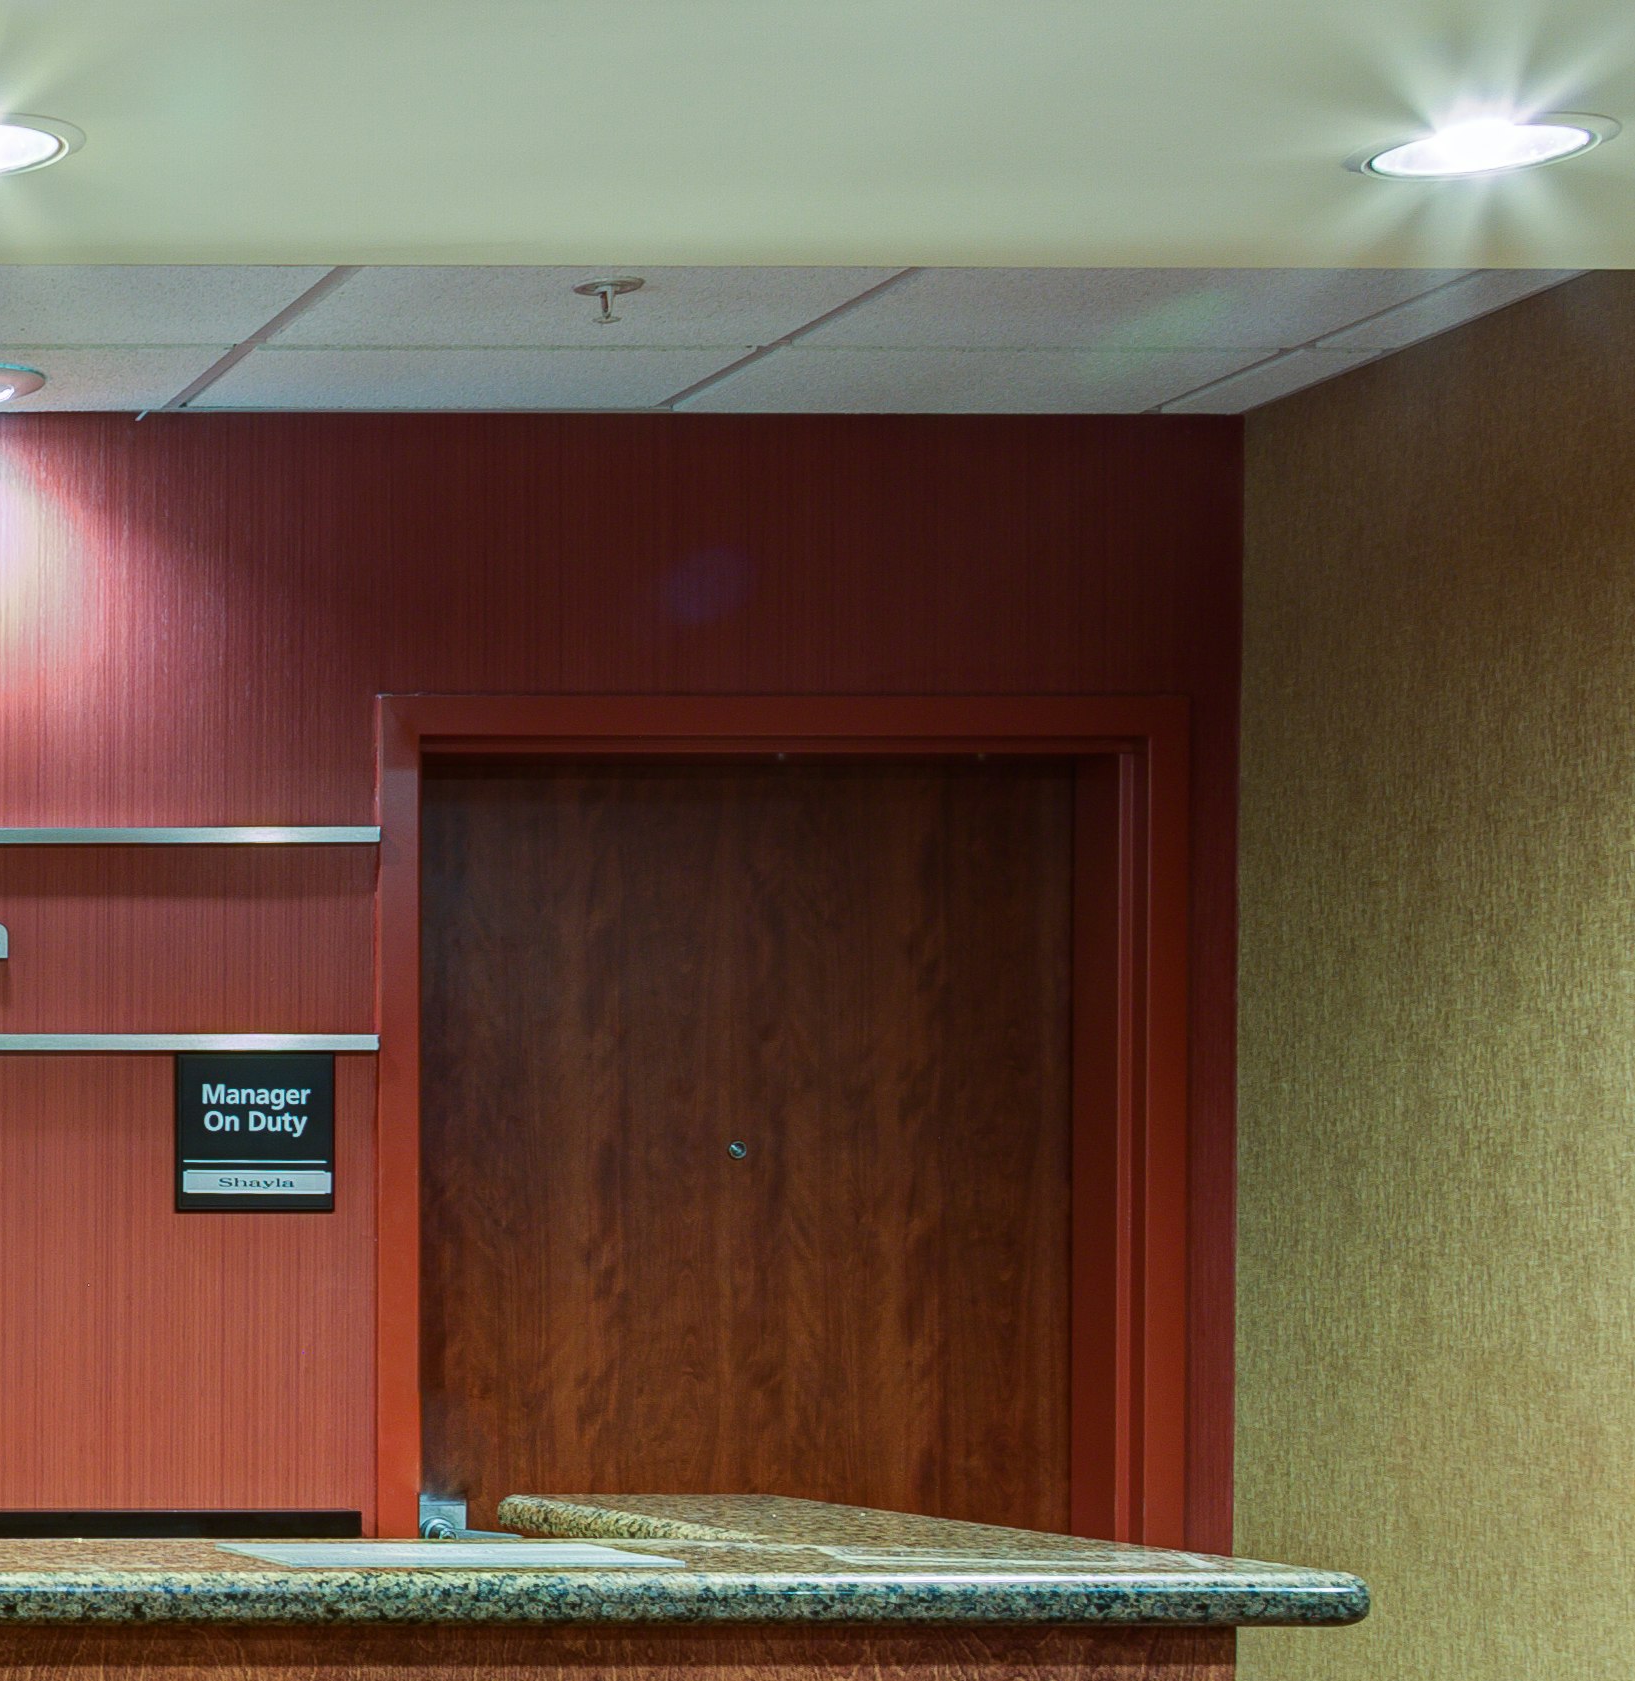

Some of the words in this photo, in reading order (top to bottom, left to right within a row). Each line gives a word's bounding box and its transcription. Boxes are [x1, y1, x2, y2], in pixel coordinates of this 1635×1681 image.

[201, 1083, 312, 1111] Manager
[203, 1110, 240, 1132] On
[248, 1110, 309, 1138] Duty
[218, 1177, 295, 1190] Shayla
